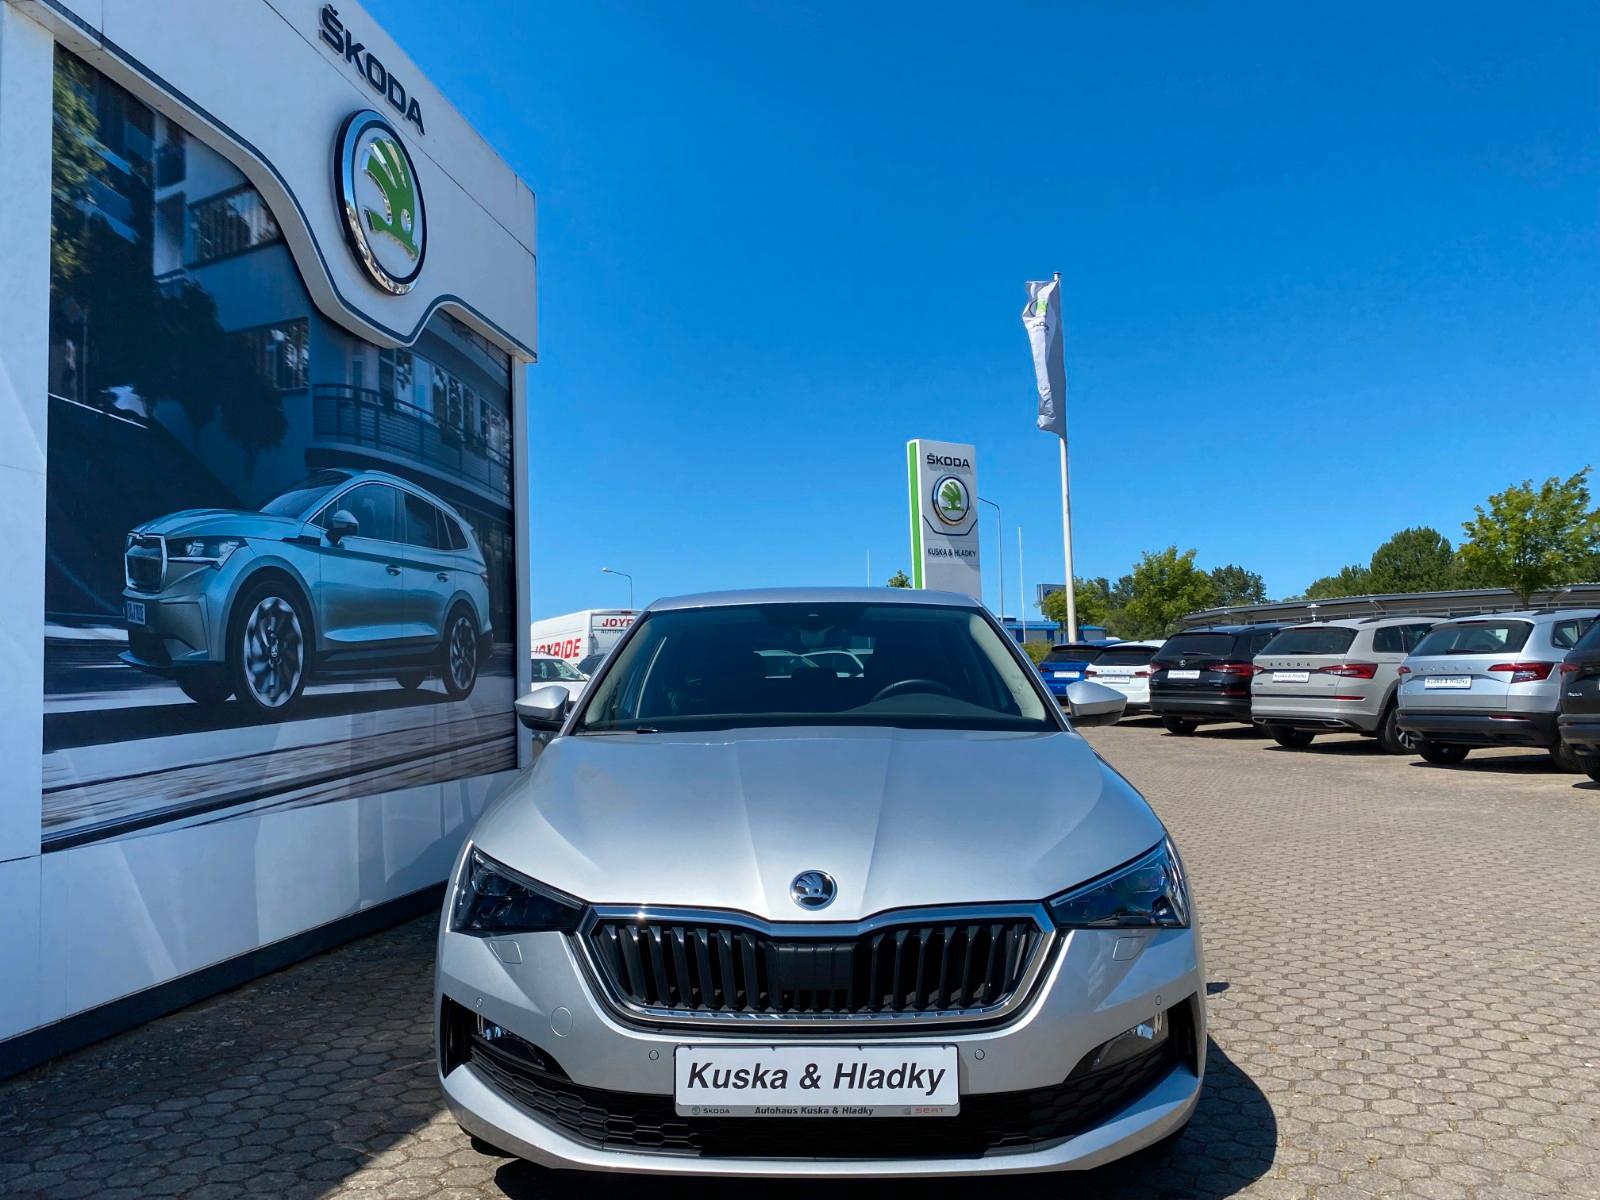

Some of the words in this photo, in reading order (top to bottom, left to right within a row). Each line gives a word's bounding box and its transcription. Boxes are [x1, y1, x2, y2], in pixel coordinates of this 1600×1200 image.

[320, 3, 425, 136] ŠKODA
[926, 453, 971, 468] ŠKODA
[927, 548, 948, 557] KUSKA
[955, 549, 976, 558] HLADKY
[687, 1062, 788, 1090] Kuska
[799, 1063, 822, 1090] &
[833, 1062, 946, 1097] Hladky
[754, 1106, 798, 1114] Autohaus
[801, 1106, 829, 1114] Kuska
[832, 1106, 839, 1115] &
[842, 1106, 874, 1116] Hladky
